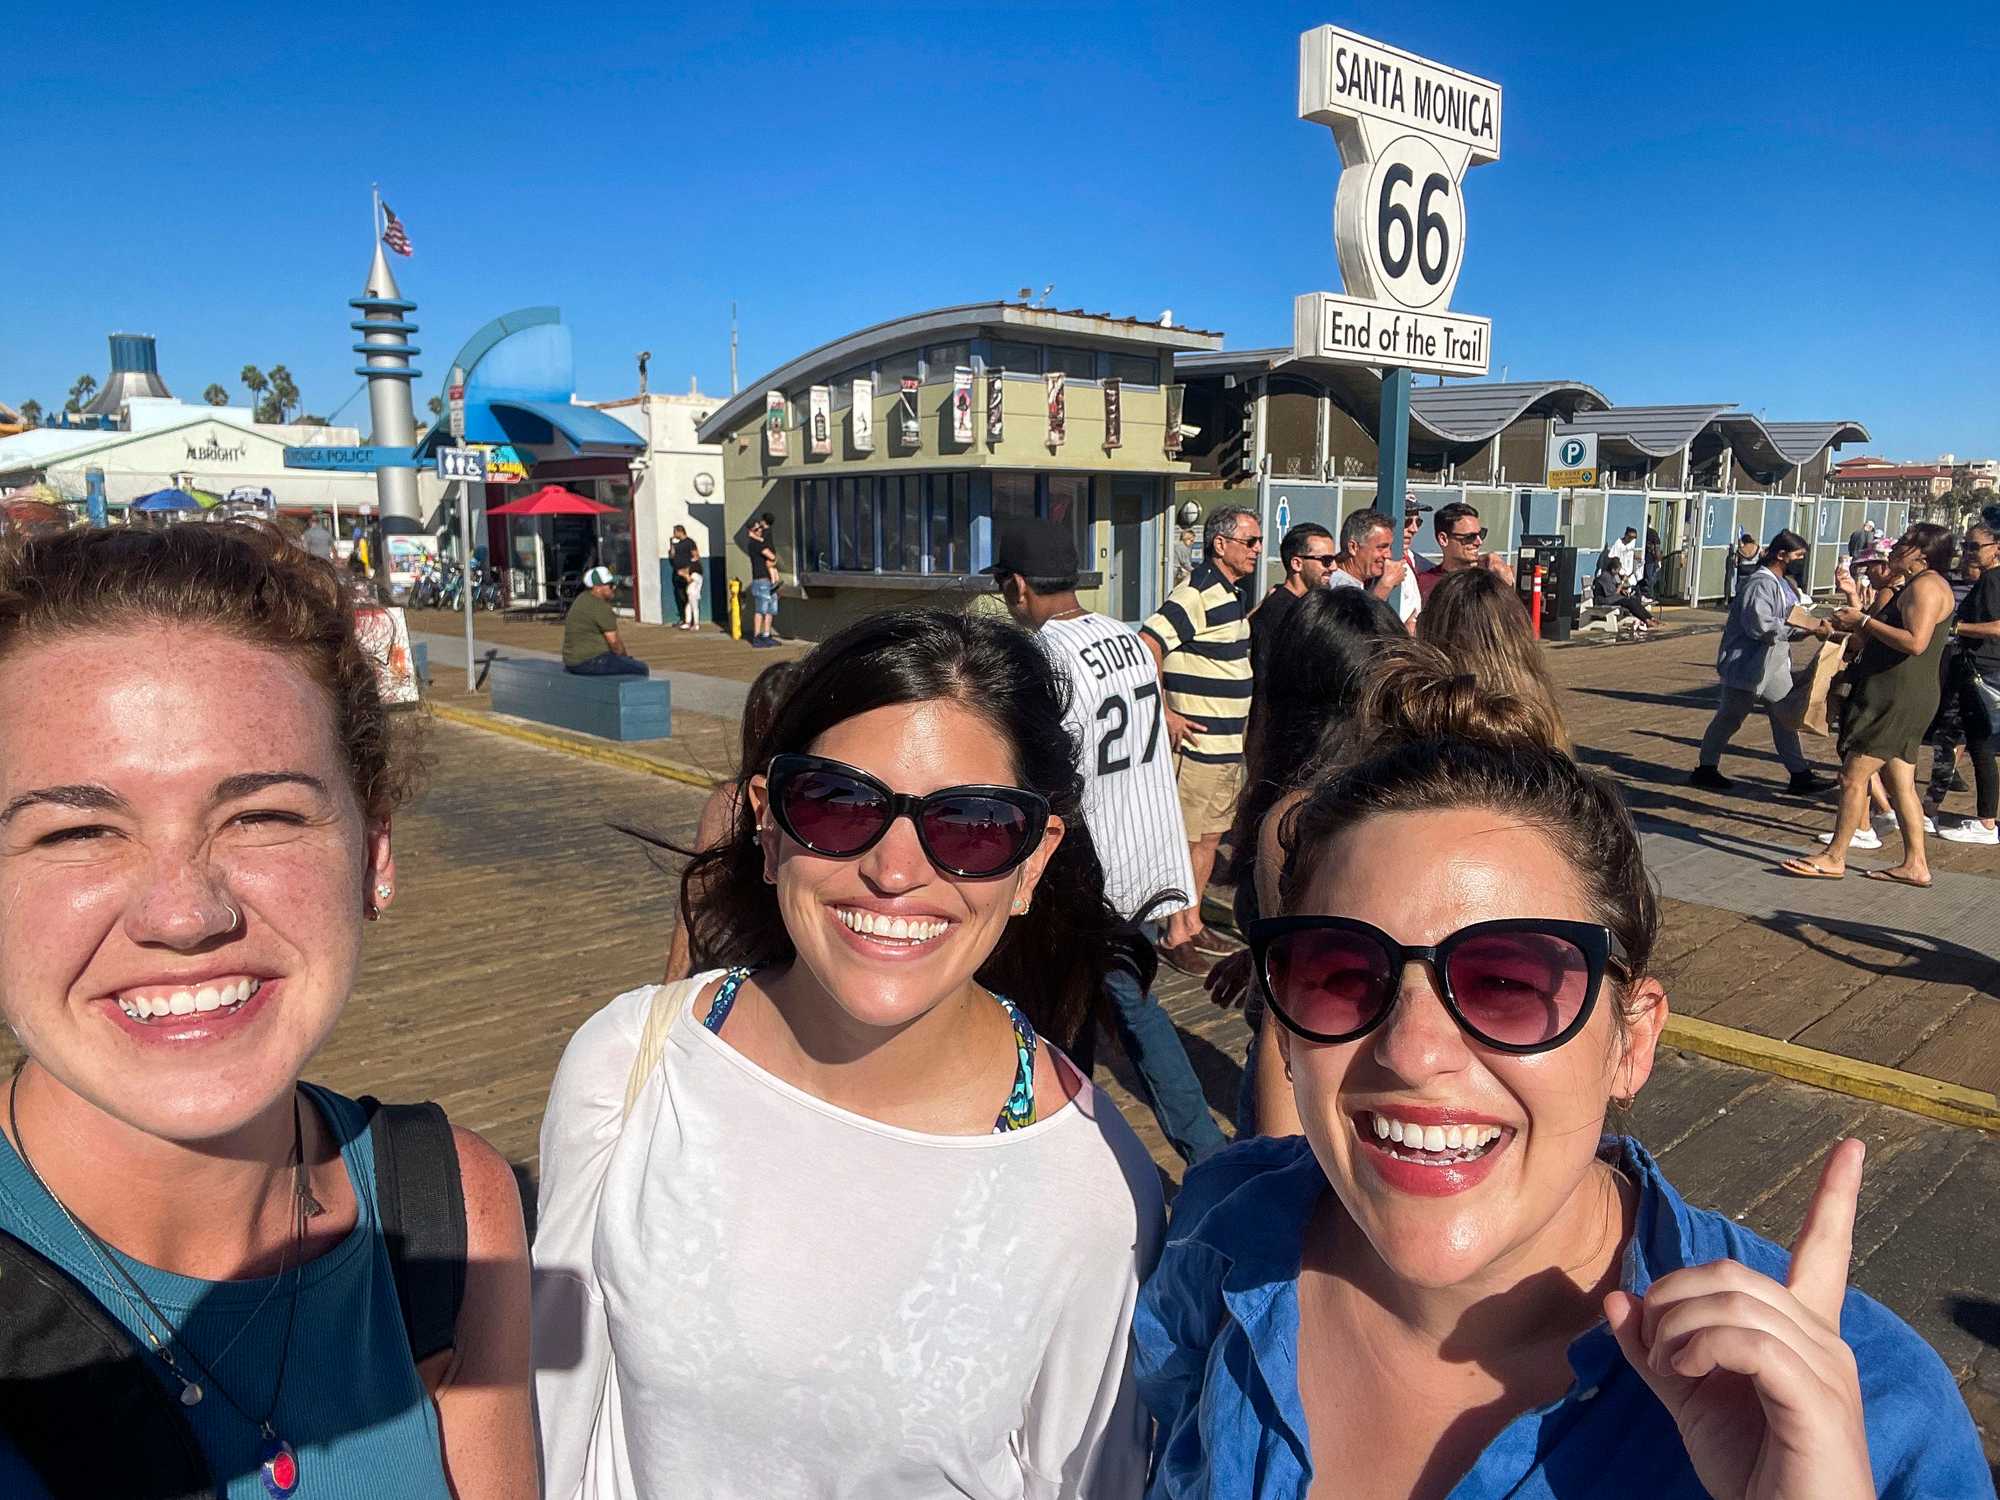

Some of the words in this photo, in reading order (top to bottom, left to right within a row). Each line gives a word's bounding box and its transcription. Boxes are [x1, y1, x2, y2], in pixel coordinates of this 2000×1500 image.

[1335, 47, 1405, 113] SANTA
[1414, 76, 1493, 140] MONICA
[1378, 162, 1450, 286] 66
[1331, 311, 1371, 350] End
[1379, 316, 1401, 352] of
[1406, 325, 1436, 356] the
[1443, 327, 1482, 362] Trail
[186, 446, 239, 462] ALBRIGHT
[327, 448, 375, 464] POLICE
[1079, 633, 1147, 680] STORY
[1096, 681, 1161, 776] 27
